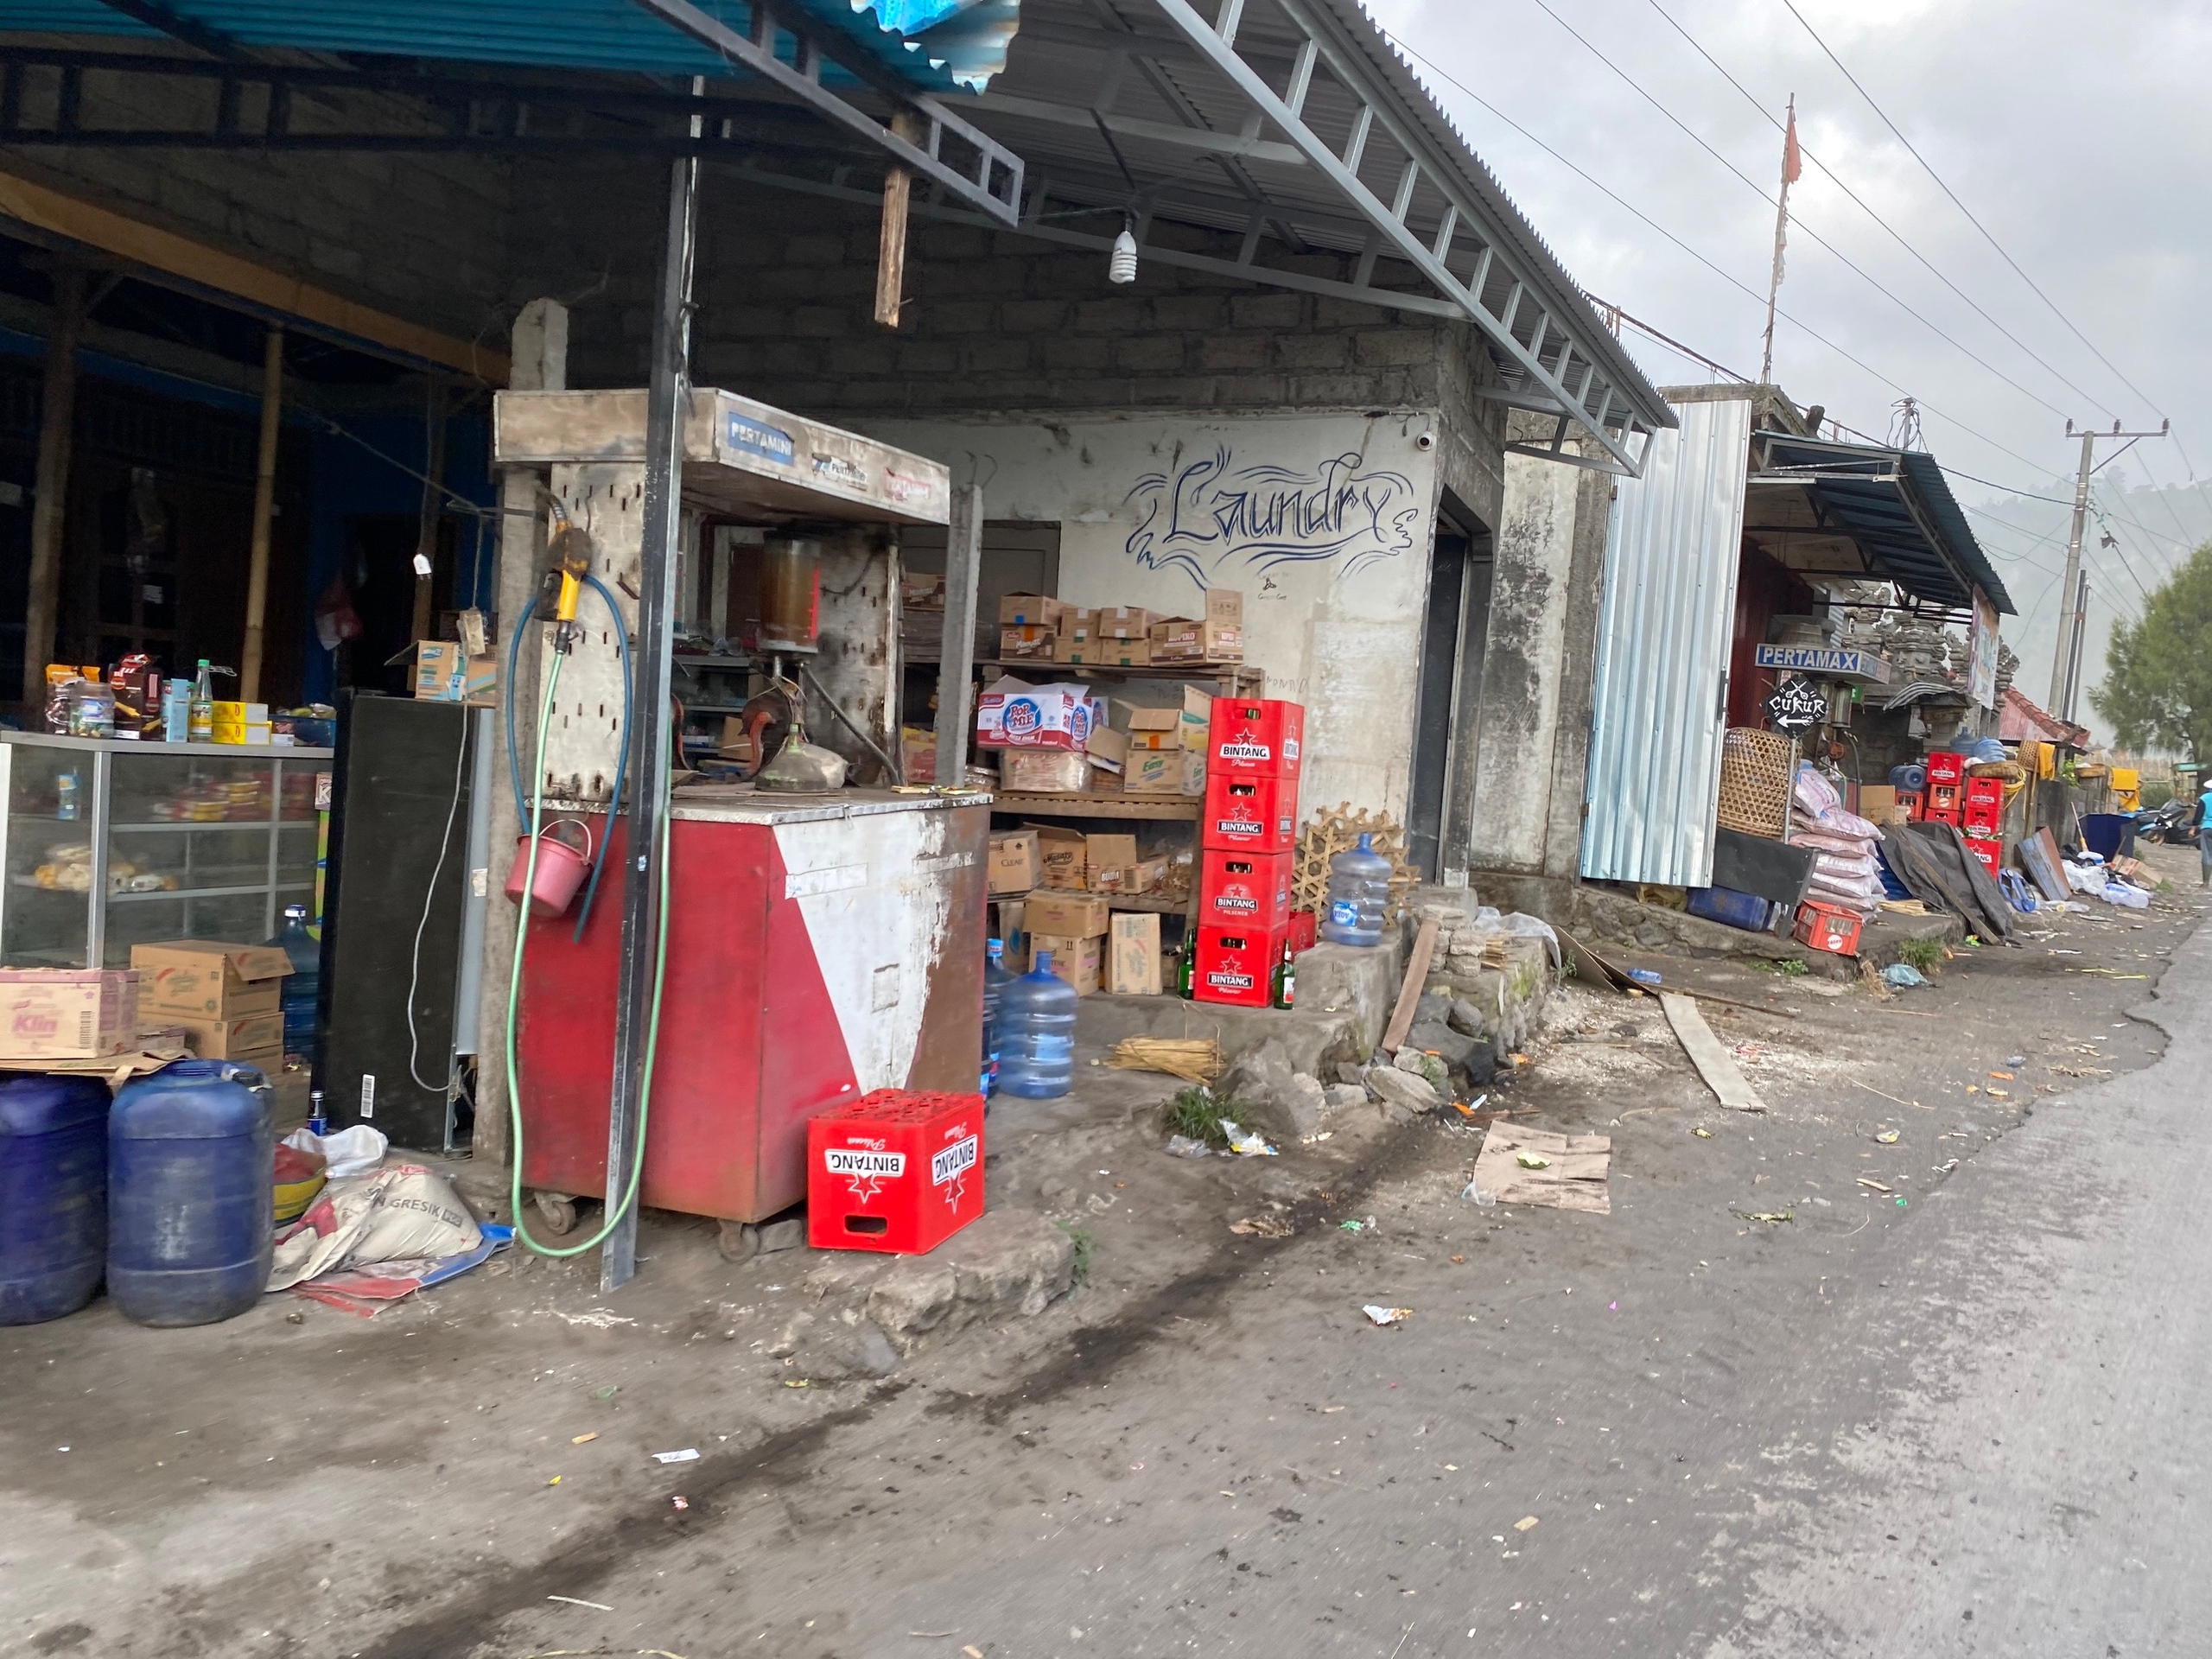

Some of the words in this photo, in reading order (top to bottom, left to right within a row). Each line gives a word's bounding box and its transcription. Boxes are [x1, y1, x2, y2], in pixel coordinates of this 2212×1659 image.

[731, 422, 792, 456] PERTAMINI
[1163, 452, 1392, 544] Laundry
[1763, 647, 1858, 670] PERTAMAX
[1010, 703, 1030, 717] POP
[1768, 695, 1826, 715] CUKUR
[1012, 713, 1033, 726] MIE
[1224, 746, 1268, 758] BINTANG
[1220, 823, 1259, 833] BINTANG
[1217, 898, 1255, 908] BINTANG
[1211, 975, 1249, 985] BINTANG
[831, 1154, 899, 1173] BINTANG
[935, 1141, 974, 1179] BINTANG
[391, 1198, 441, 1217] GRESIK
